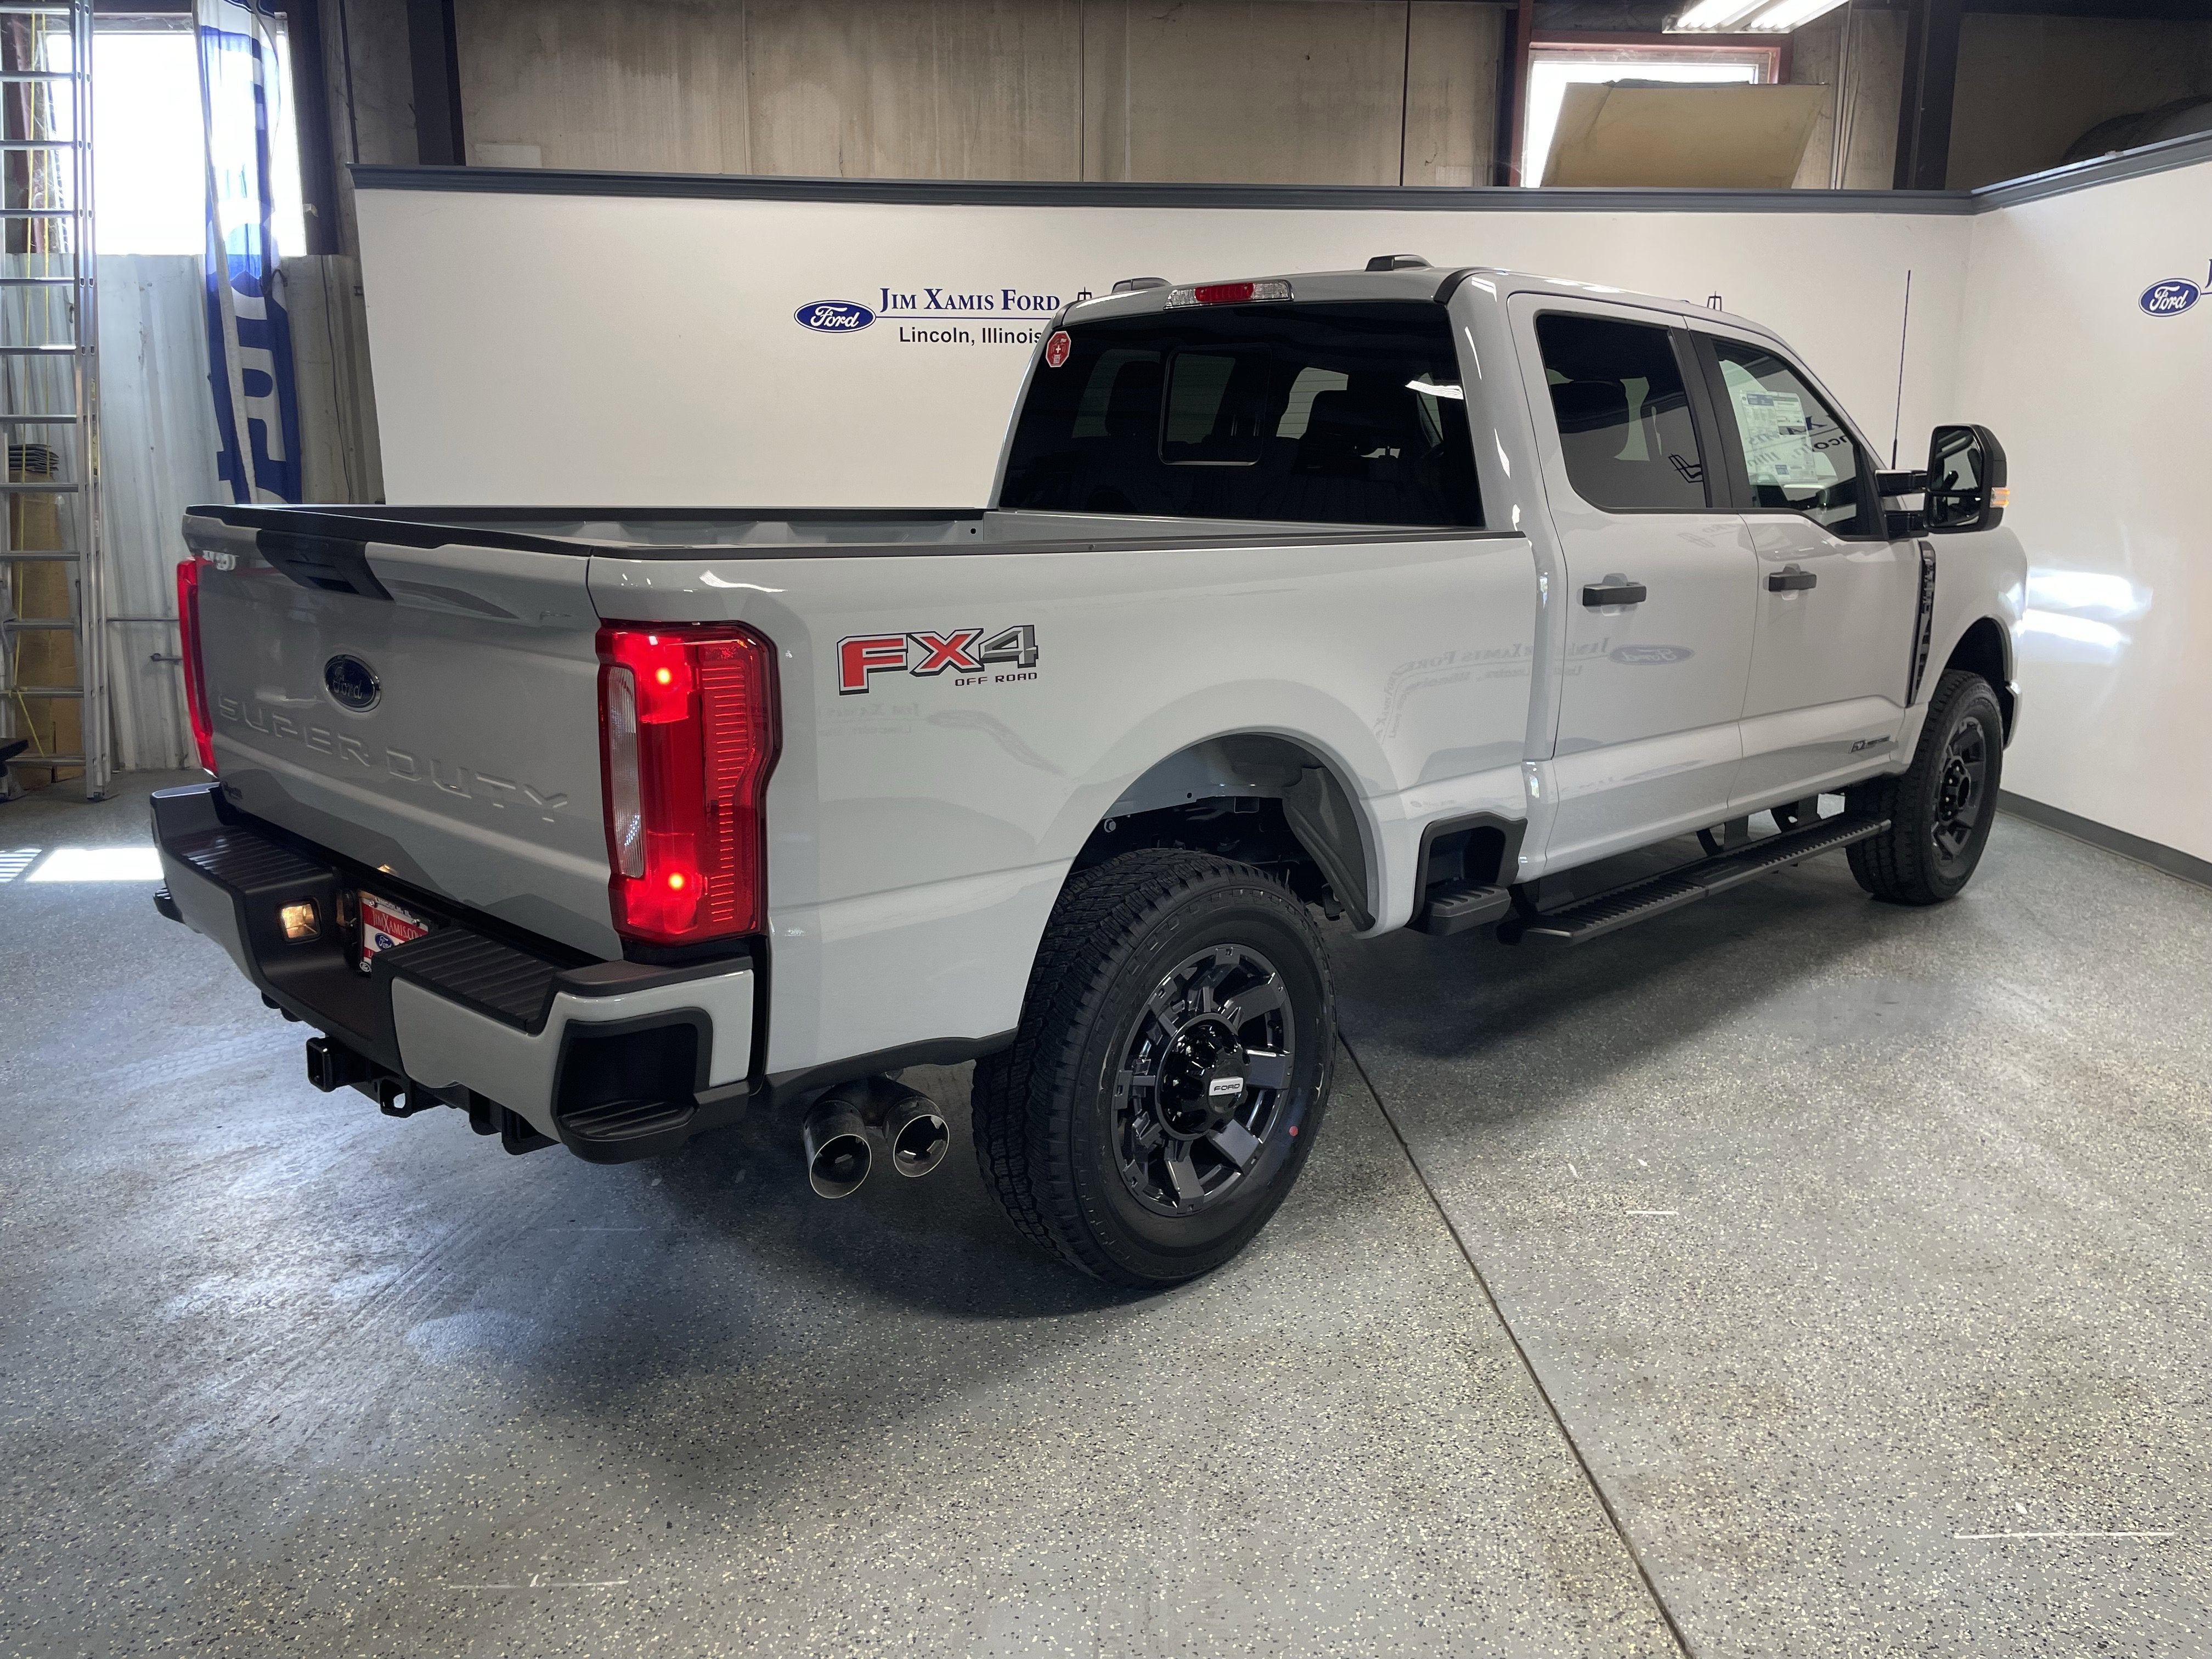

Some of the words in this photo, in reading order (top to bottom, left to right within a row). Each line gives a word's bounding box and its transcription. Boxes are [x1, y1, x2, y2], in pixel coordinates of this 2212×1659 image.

[879, 287, 917, 313] JIM
[923, 288, 994, 311] XAMIS
[1001, 289, 1060, 311] FORD
[2149, 285, 2189, 311] Ford
[810, 306, 860, 328] Ford
[899, 326, 975, 346] Lincoln,
[982, 328, 1042, 343] Illinois
[837, 624, 1039, 696] FX4
[332, 665, 363, 699] Ford
[955, 678, 988, 687] OFF
[995, 672, 1037, 684] ROAD
[219, 693, 371, 767] SUPER
[386, 747, 568, 822] DUTY
[379, 935, 392, 949] Ford
[1214, 1084, 1240, 1092] FORD
